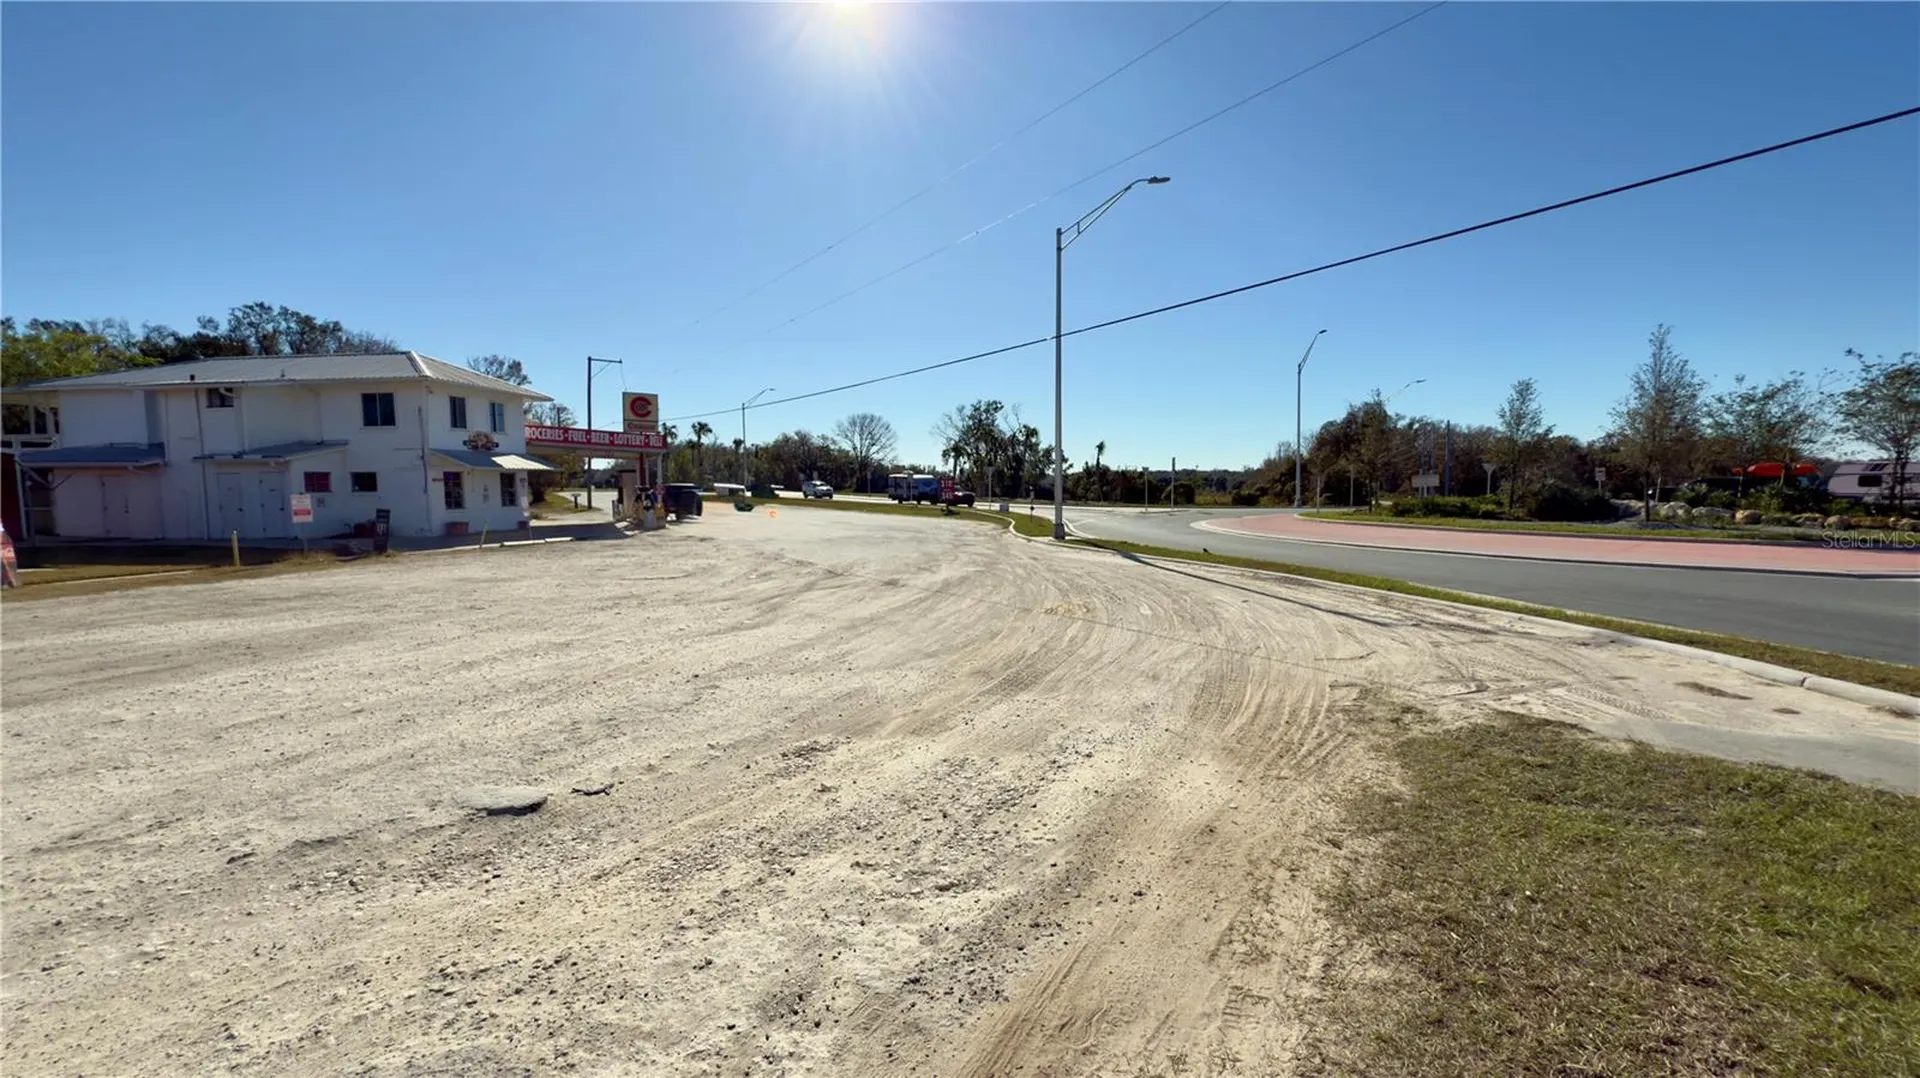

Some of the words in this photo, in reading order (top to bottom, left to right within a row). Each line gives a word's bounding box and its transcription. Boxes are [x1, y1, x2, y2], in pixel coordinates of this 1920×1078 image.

[524, 427, 564, 441] ROCERIES
[568, 430, 587, 443] FUEL
[591, 432, 609, 444] BEER
[614, 433, 645, 446] LOTTERY
